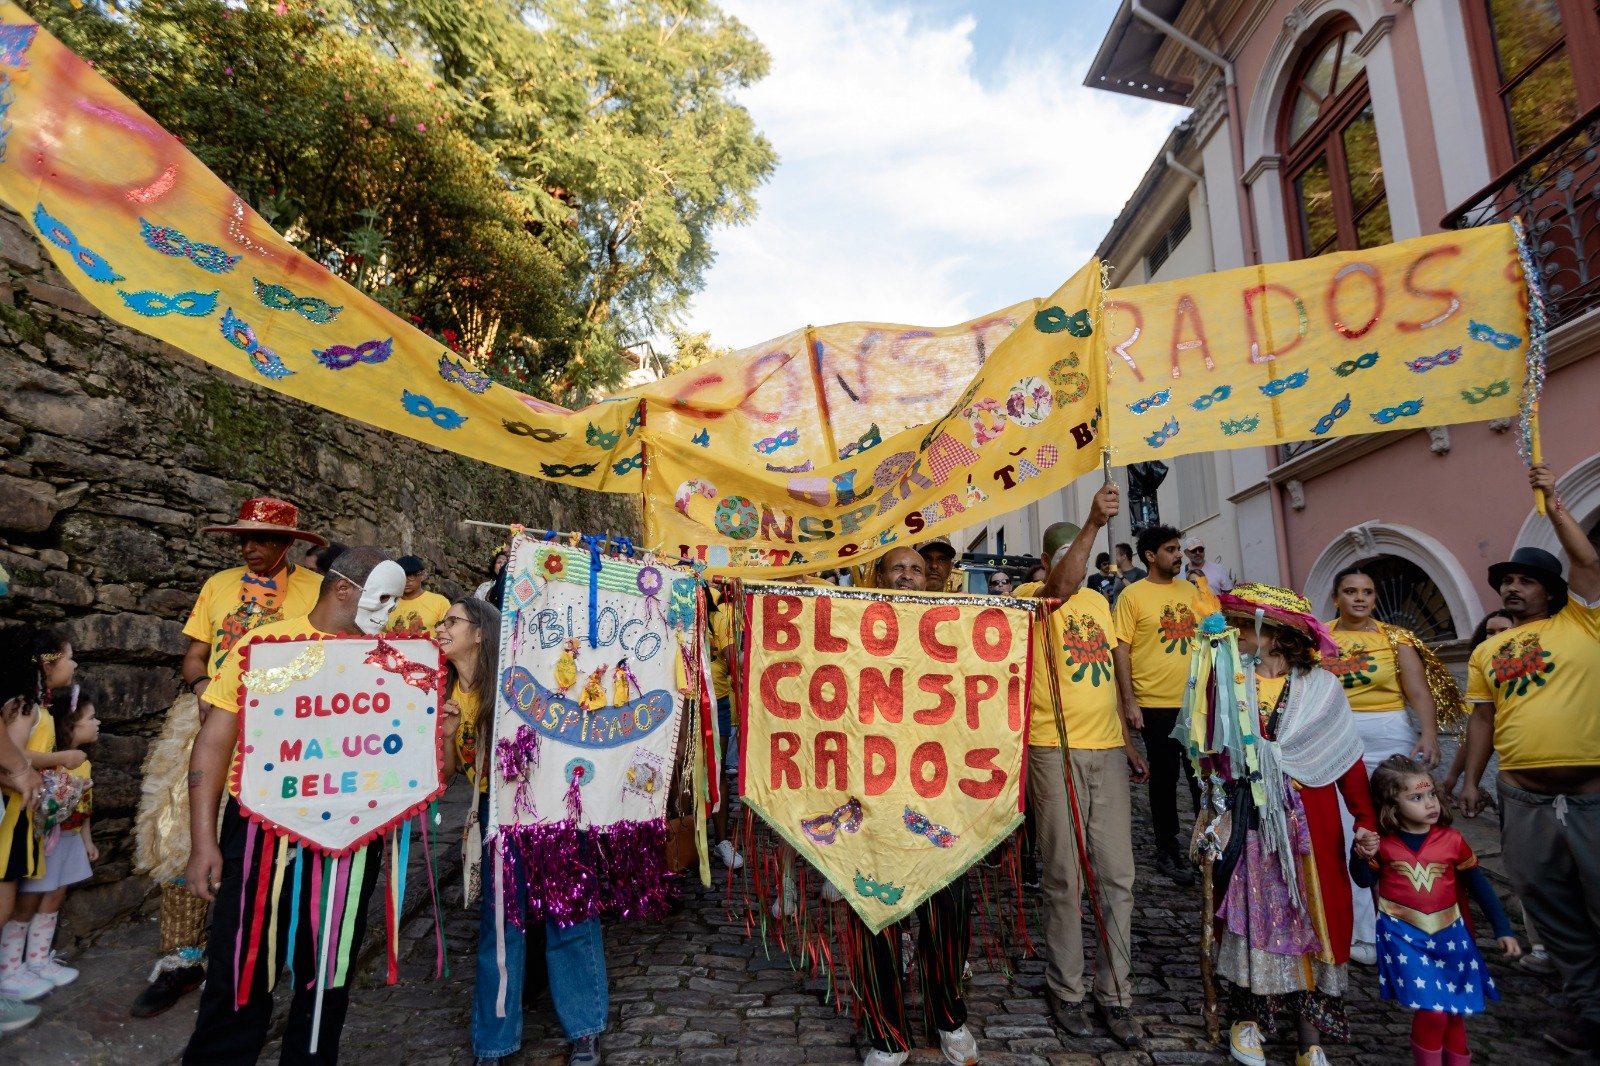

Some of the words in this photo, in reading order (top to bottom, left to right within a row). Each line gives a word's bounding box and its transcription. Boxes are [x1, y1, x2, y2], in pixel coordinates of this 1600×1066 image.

[993, 444, 1059, 491] TÃO
[528, 606, 662, 661] BLOCO
[762, 594, 1012, 663] BLOCO
[294, 691, 392, 719] BLOCO
[505, 672, 667, 742] CONSPIRADOS
[279, 733, 404, 763] MALUCO
[770, 730, 1008, 800] RADOS
[281, 769, 401, 799] BELEZA
